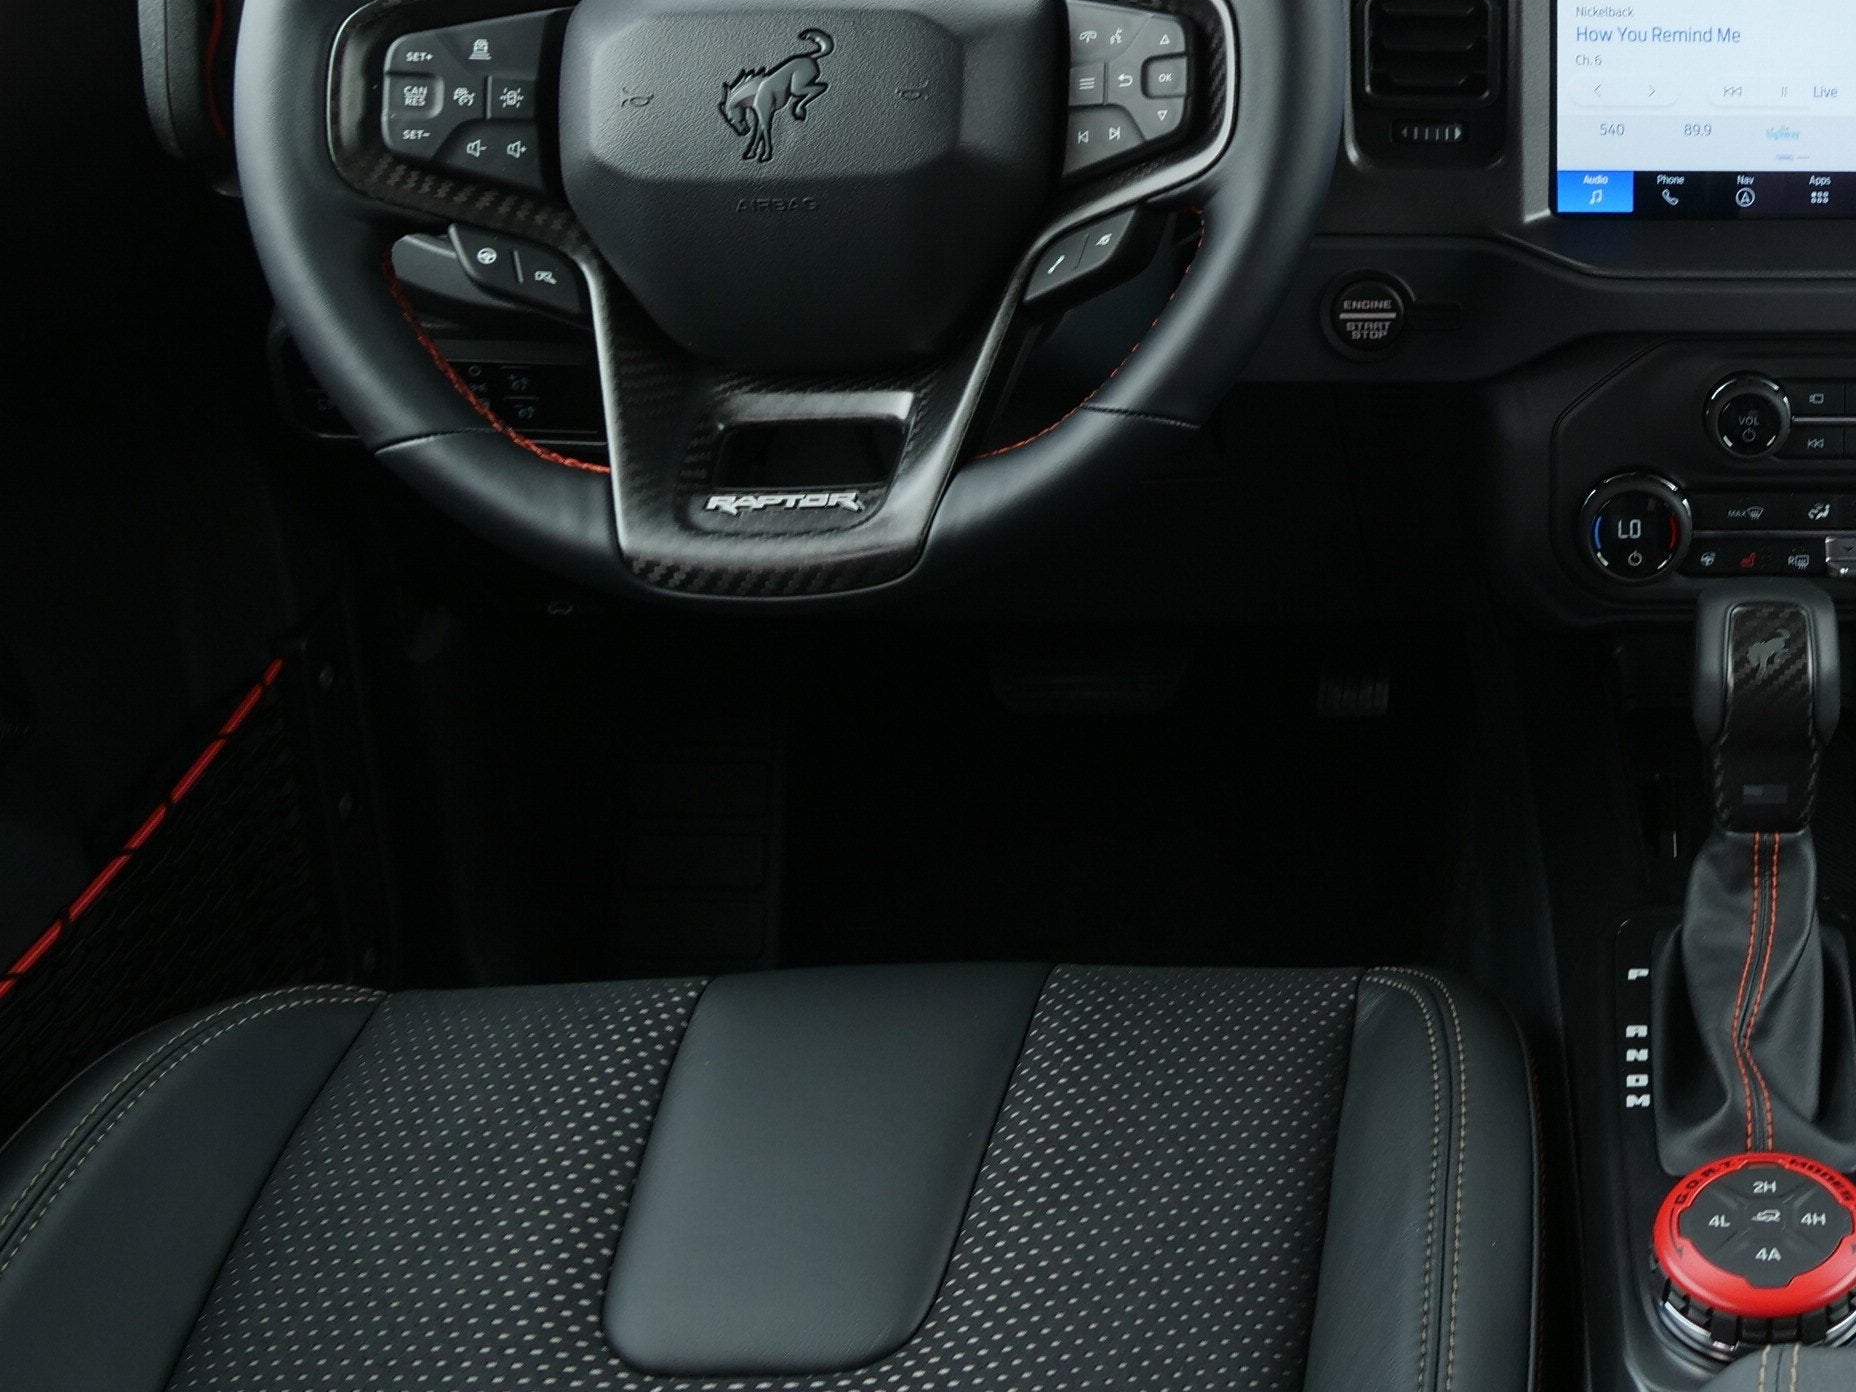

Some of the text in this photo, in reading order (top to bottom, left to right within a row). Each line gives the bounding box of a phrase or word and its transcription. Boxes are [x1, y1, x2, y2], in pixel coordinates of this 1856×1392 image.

[1575, 5, 1635, 19] Nickelback
[1575, 26, 1742, 44] How You Remind Me
[405, 51, 435, 63] SET+
[1575, 54, 1603, 67] Ch. 6
[1158, 72, 1173, 83] OK
[1812, 85, 1839, 99] Live
[1599, 123, 1625, 137] 540
[1683, 123, 1713, 137] 89.9
[1582, 174, 1609, 186] Audio
[1656, 174, 1685, 186] Phone
[1736, 174, 1755, 186] Nav
[1808, 175, 1833, 188] Apps
[1342, 299, 1393, 310] ENGINE
[1345, 321, 1393, 332] START
[1350, 329, 1389, 340] STOP
[1737, 415, 1760, 427] VOL
[704, 489, 868, 514] RAPTOR
[1726, 508, 1749, 519] MAX
[1627, 967, 1650, 981] P
[1625, 1024, 1649, 1039] R
[1625, 1047, 1650, 1062] N
[1625, 1073, 1650, 1088] D
[1625, 1093, 1651, 1108] M
[1752, 1180, 1777, 1194] 2H
[1707, 1213, 1731, 1229] 4L
[1799, 1212, 1827, 1227] 4H
[1754, 1247, 1783, 1262] 4A
